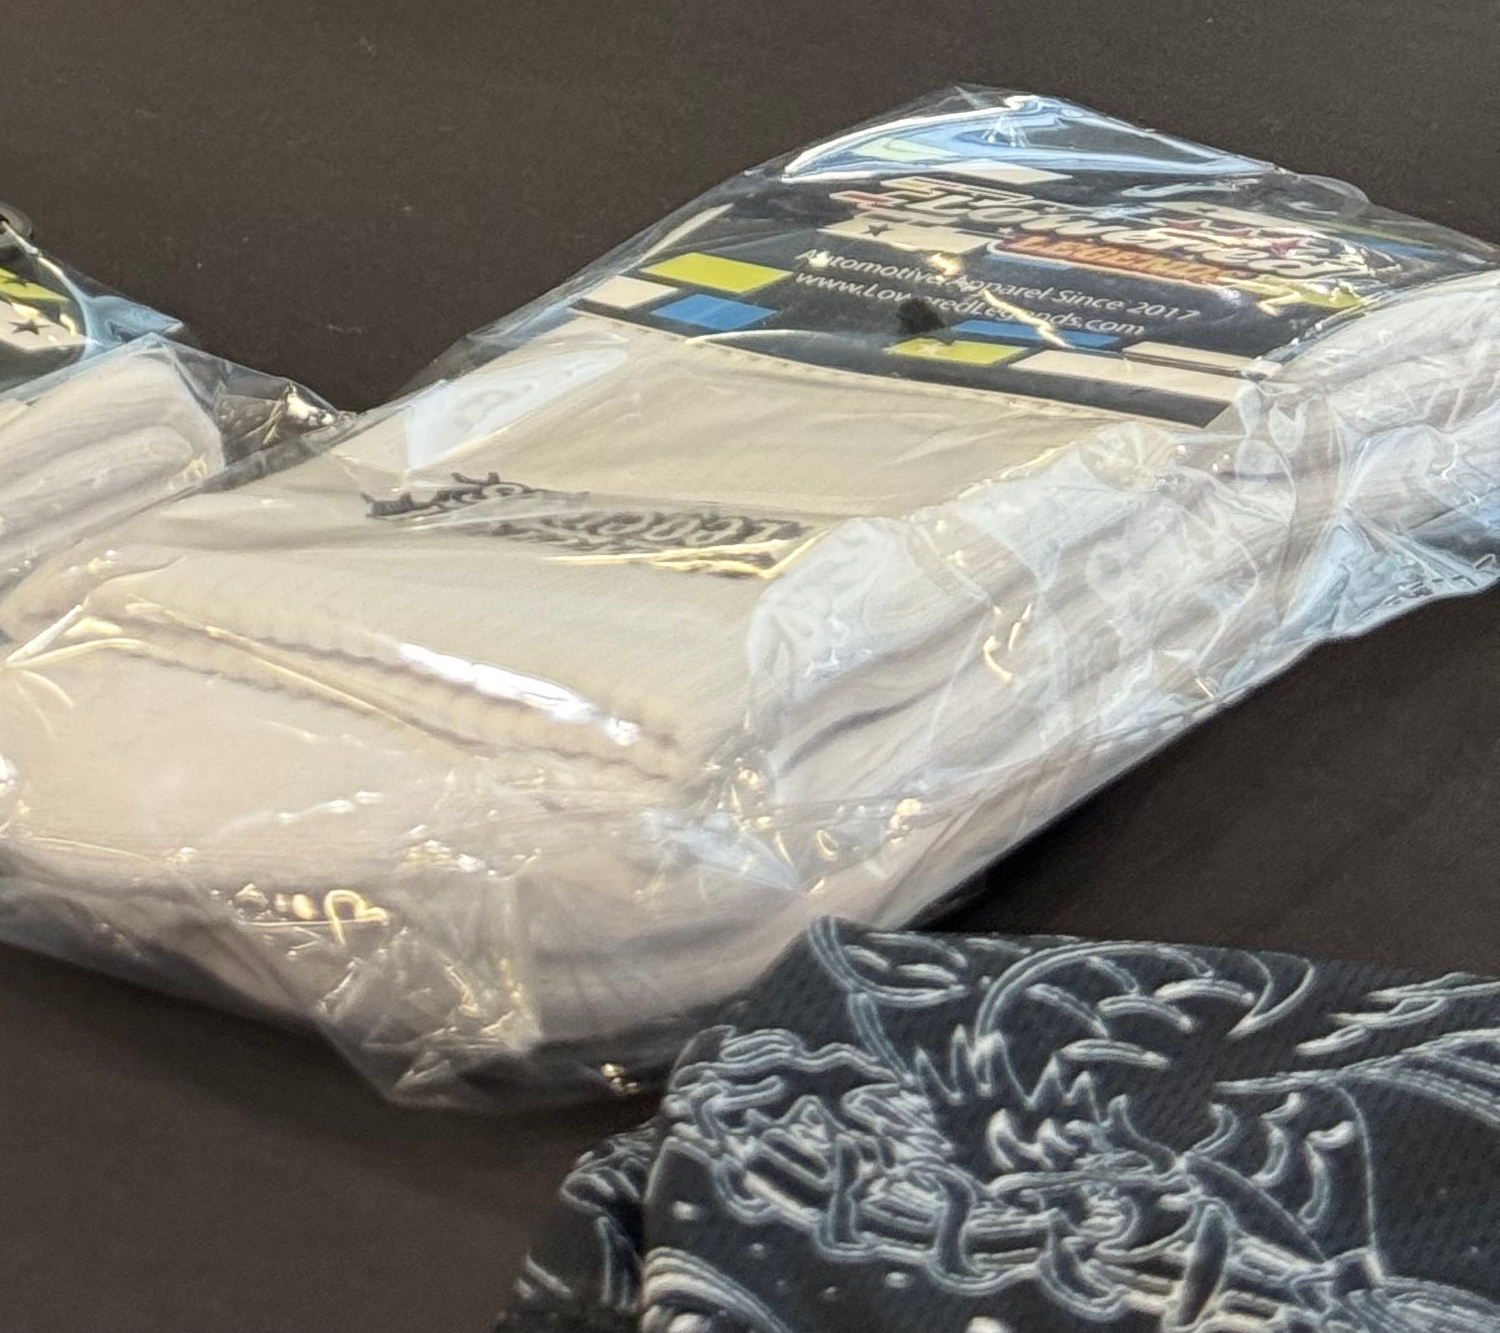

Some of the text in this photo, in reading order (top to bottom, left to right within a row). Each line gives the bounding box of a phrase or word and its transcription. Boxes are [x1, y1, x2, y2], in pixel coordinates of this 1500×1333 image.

[947, 274, 1054, 303] Apparel
[1052, 289, 1126, 312] Since
[1126, 301, 1201, 322] 2017
